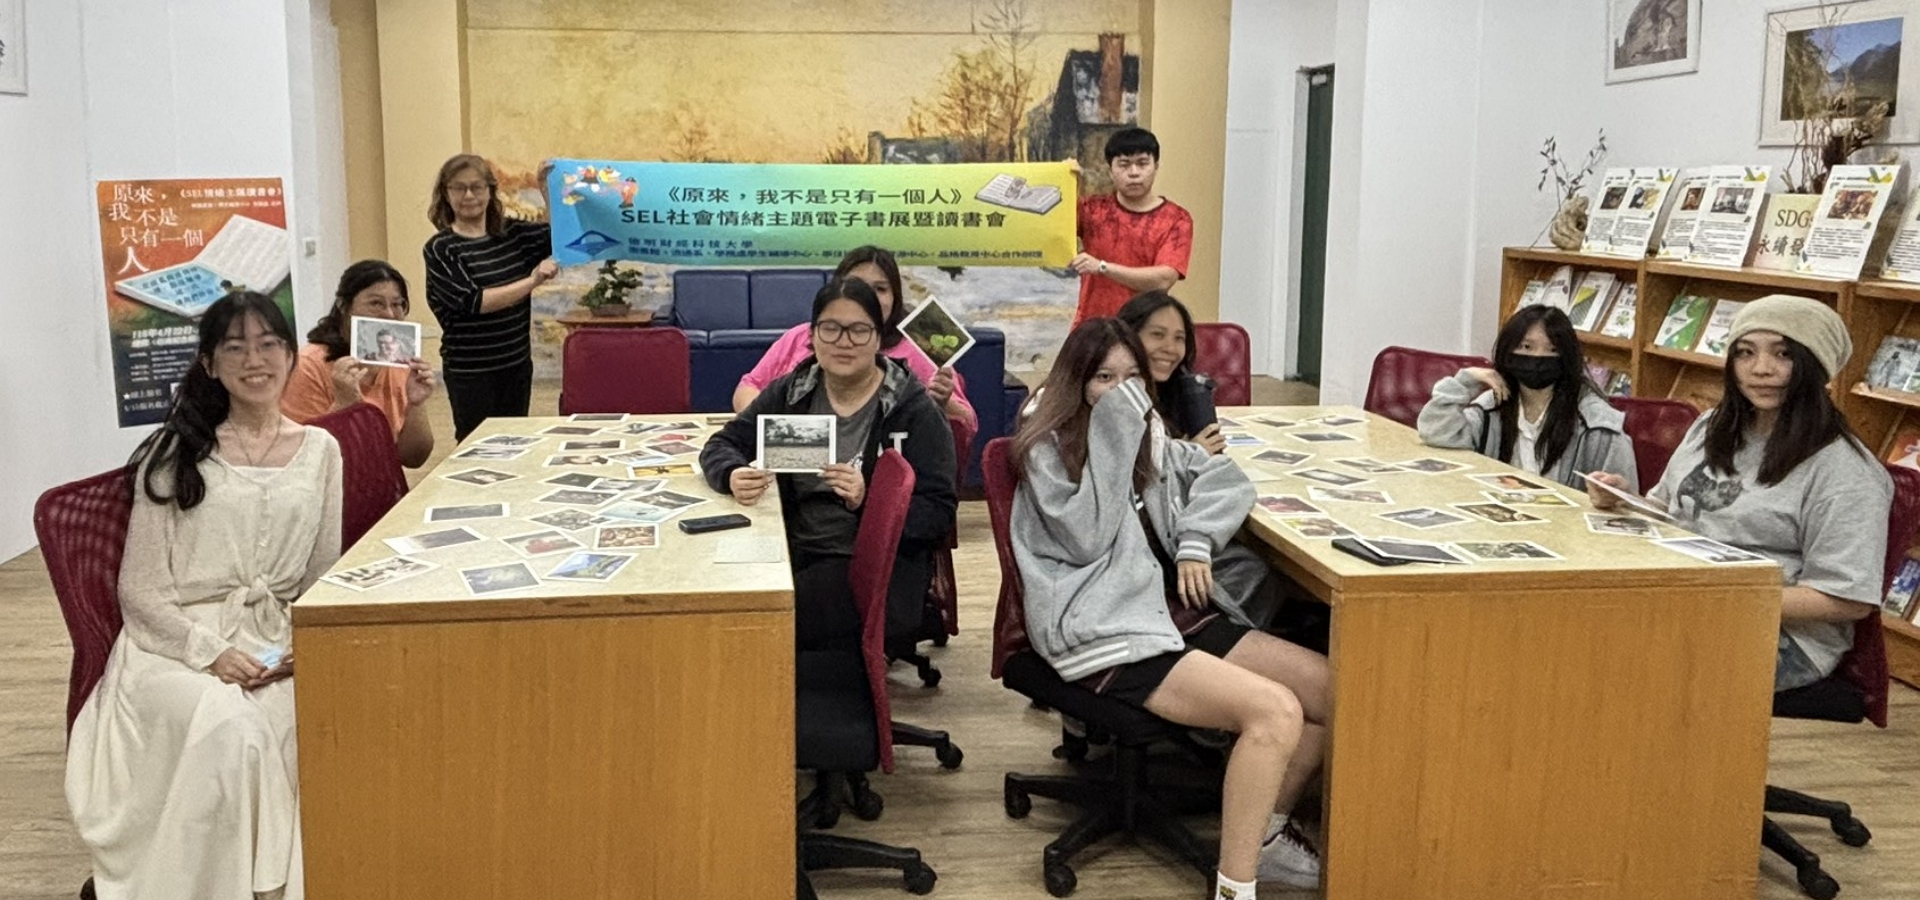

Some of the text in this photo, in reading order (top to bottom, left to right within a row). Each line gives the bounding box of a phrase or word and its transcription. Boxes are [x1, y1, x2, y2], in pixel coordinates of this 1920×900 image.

[668, 186, 962, 205] 《原來，我不是只有一個人》
[109, 204, 179, 227] 我不是
[621, 209, 1007, 228] SEL社會情緒主題電子書展暨讀書會
[119, 227, 204, 248] 只有一個
[118, 246, 150, 274] 人
